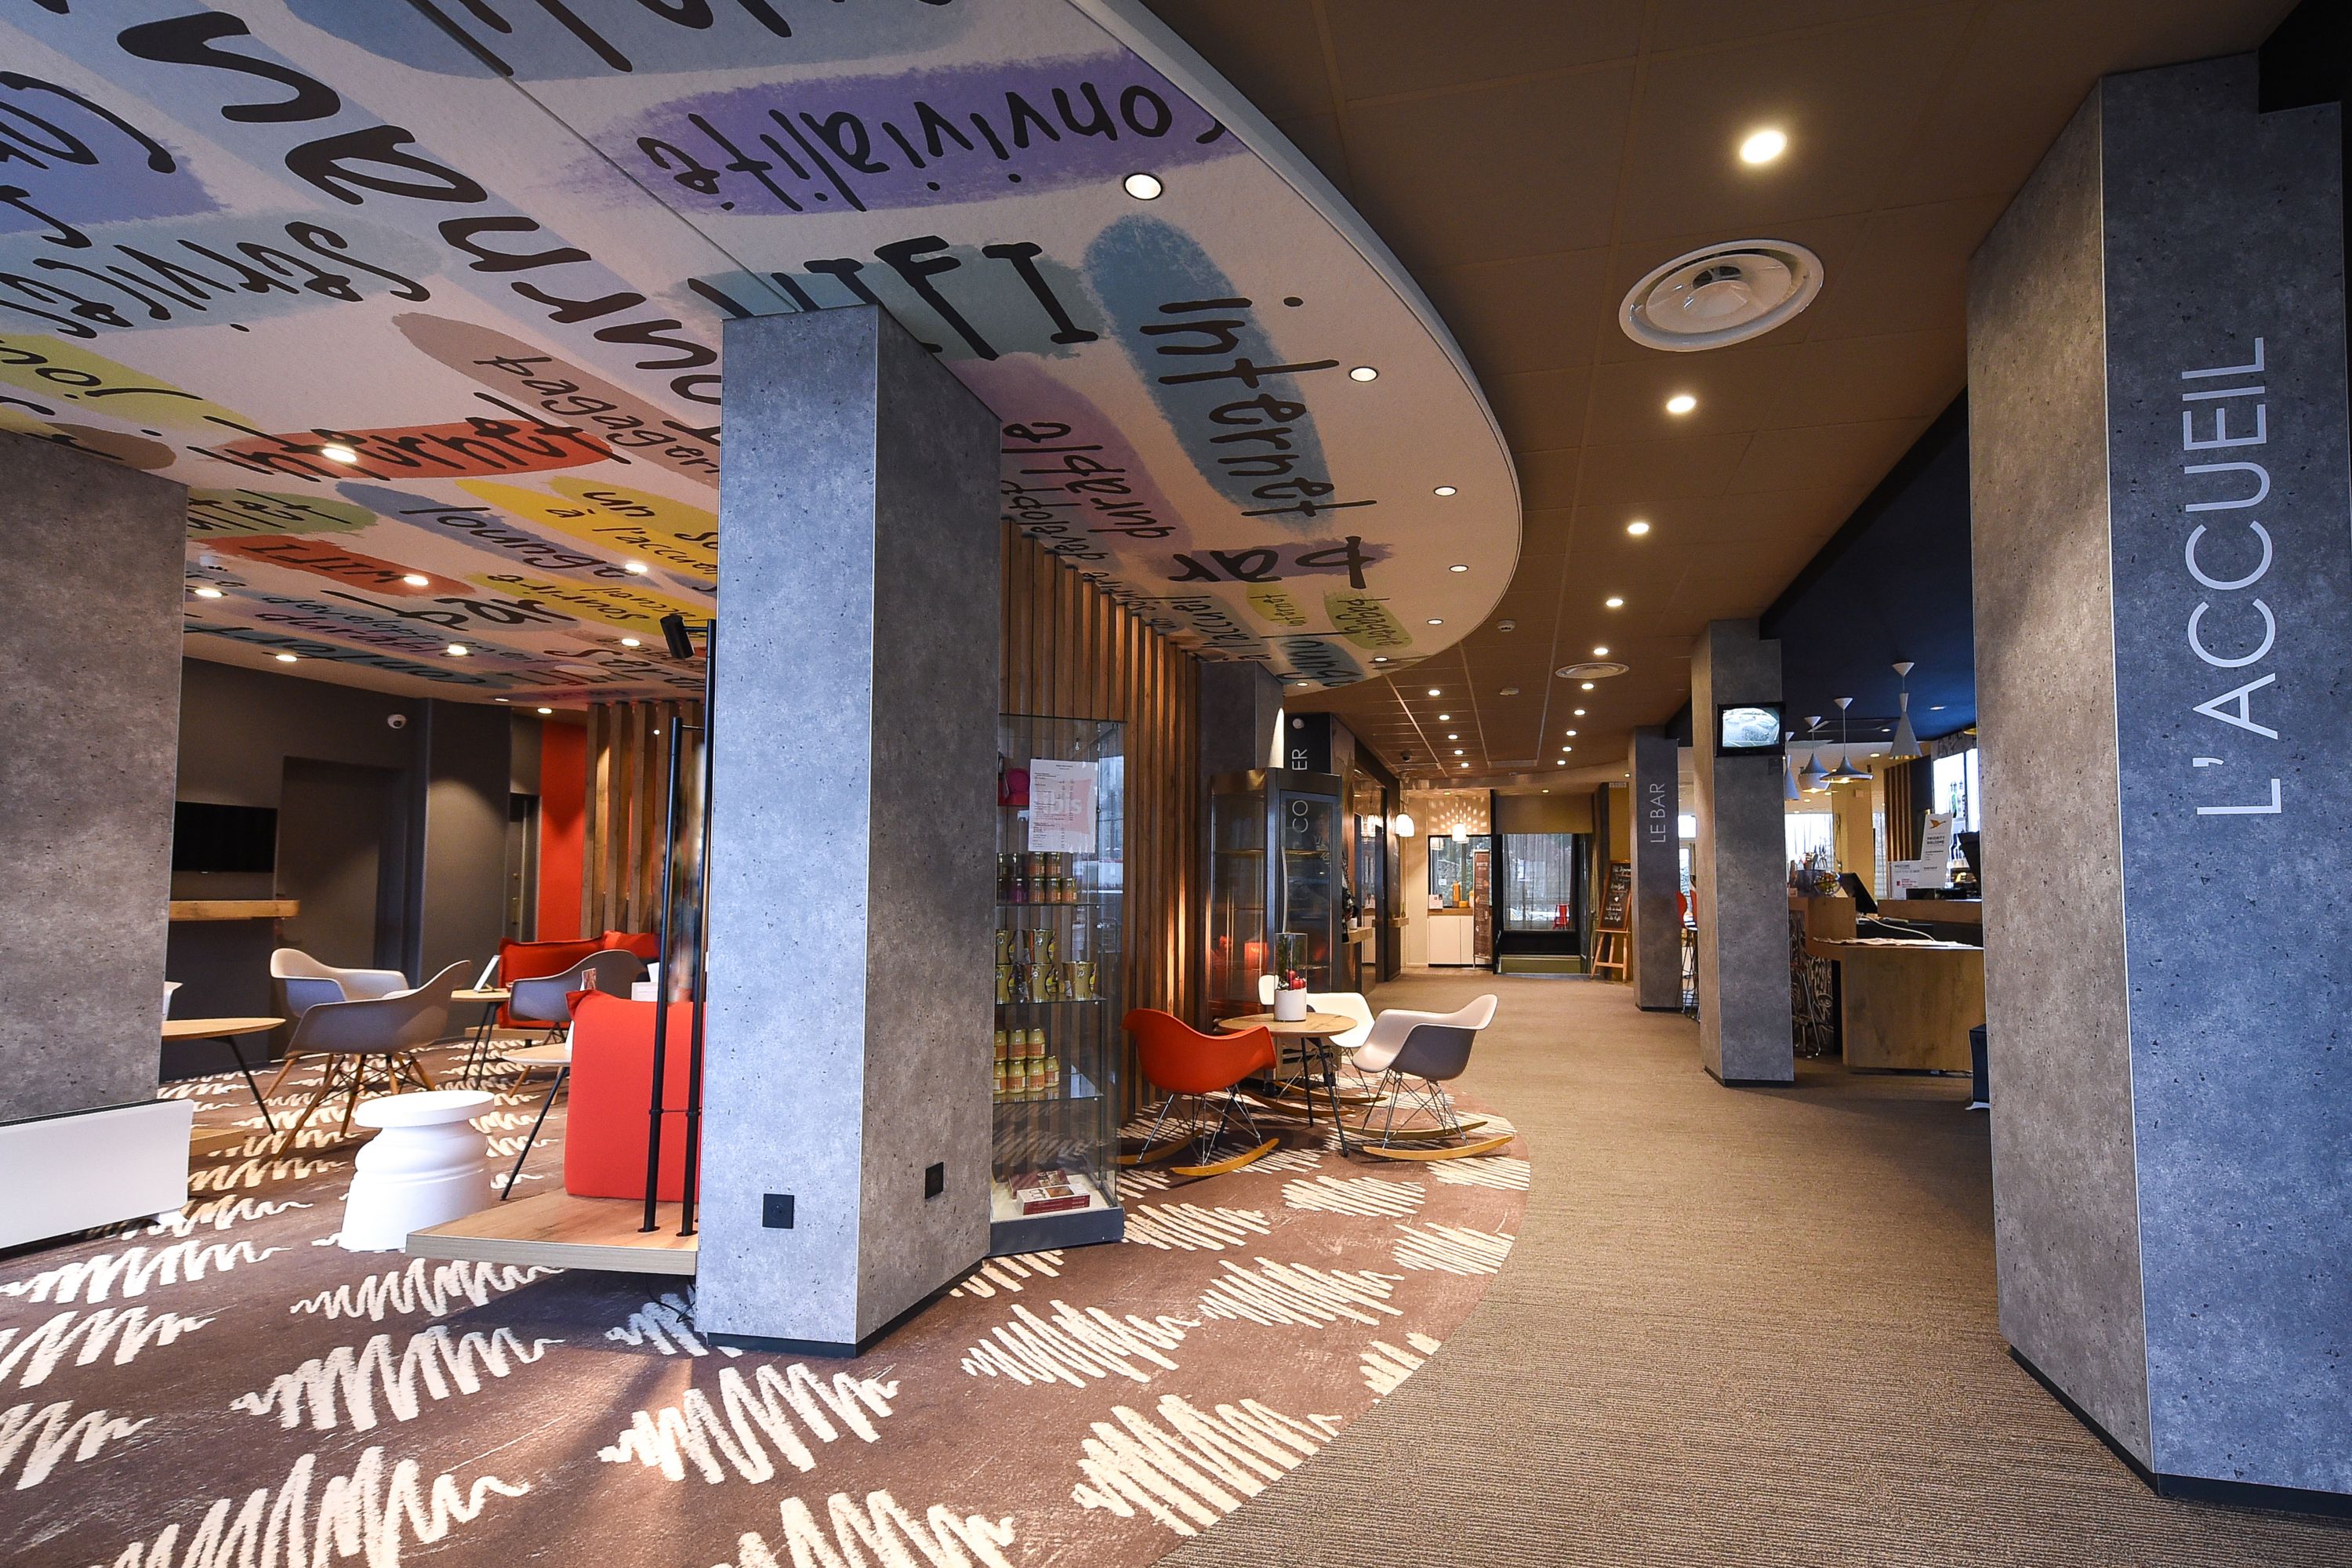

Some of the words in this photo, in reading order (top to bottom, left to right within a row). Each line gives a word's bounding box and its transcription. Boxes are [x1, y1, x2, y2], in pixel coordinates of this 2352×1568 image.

[140, 392, 632, 482] internet
[1139, 296, 1377, 517] internet
[1001, 422, 1177, 538] durable
[2182, 337, 2282, 815] L'ACCUEIL
[1650, 782, 1666, 818] BAR
[1650, 824, 1667, 844] LE
